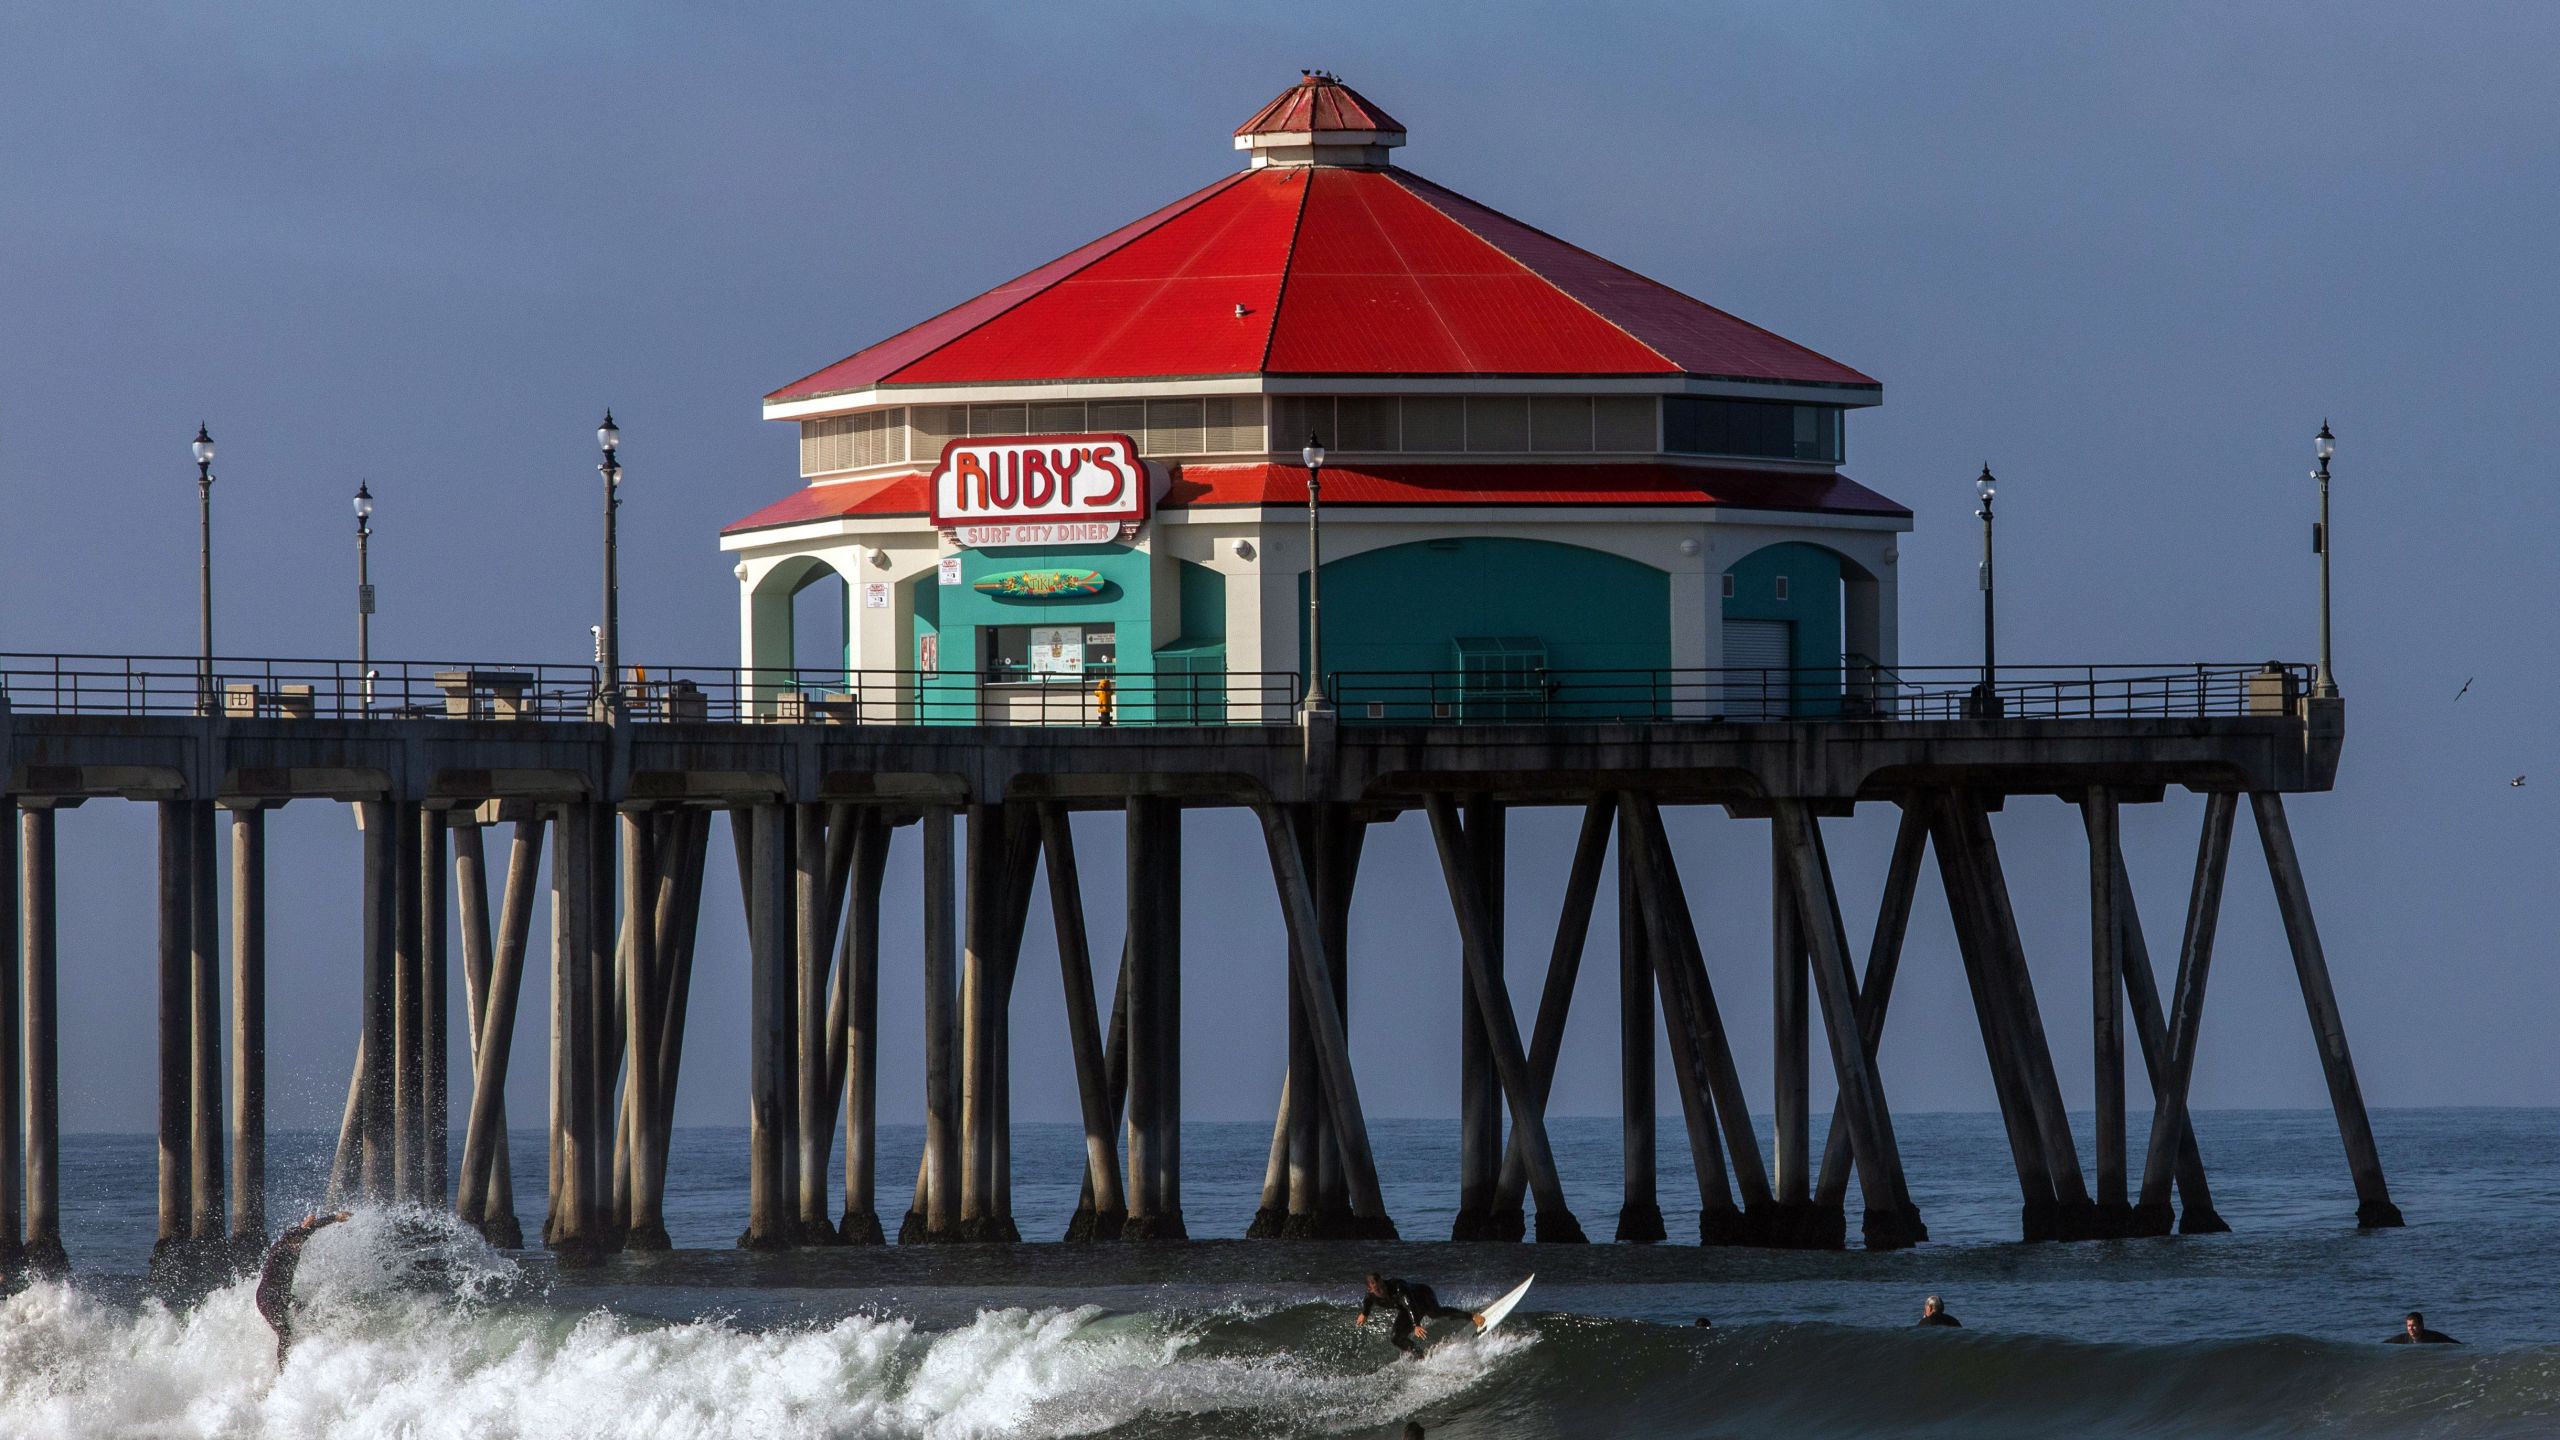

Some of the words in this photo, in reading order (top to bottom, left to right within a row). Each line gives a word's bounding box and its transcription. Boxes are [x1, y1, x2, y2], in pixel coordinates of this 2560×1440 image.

[957, 447, 1123, 509] RUBY'S
[967, 527, 1011, 544] SURF
[1015, 525, 1053, 542] CITY
[1057, 523, 1109, 541] DINER
